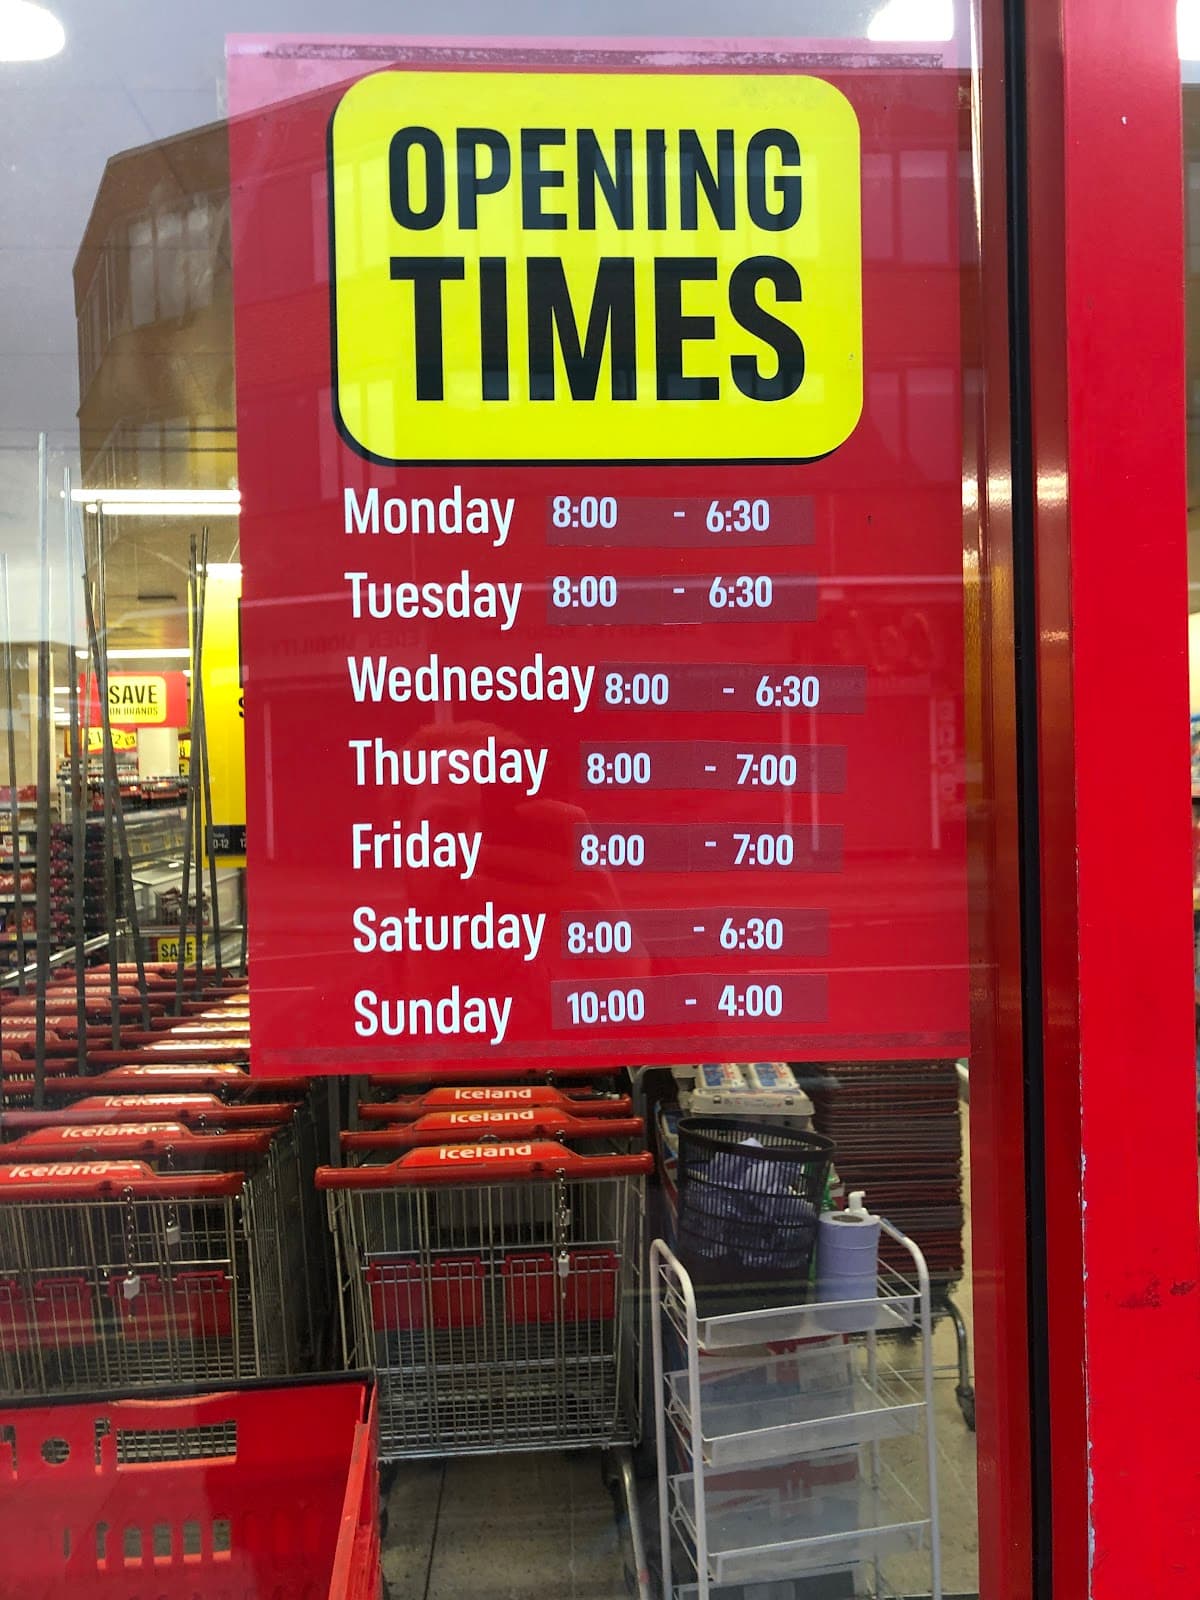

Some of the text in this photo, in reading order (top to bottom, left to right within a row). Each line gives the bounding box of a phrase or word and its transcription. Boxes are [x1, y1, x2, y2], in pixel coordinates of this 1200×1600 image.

[389, 126, 802, 232] OPENING
[389, 255, 805, 402] TIMES
[344, 485, 515, 547] Monday
[551, 495, 618, 529] 8:00
[706, 499, 770, 533] 6:30
[344, 569, 523, 631] Tuesday
[551, 575, 618, 608] 8:00
[708, 575, 773, 609] 6:30
[109, 685, 158, 704] SAVE
[347, 652, 596, 713] Wednesday
[604, 672, 669, 706] 8:00
[755, 675, 820, 708] 6:30
[348, 735, 549, 797] Thursday
[586, 752, 651, 786] 8:00
[736, 753, 797, 787] 7:00
[352, 819, 483, 881] Friday
[580, 834, 645, 867] 8:00
[733, 833, 794, 867] 7:00
[161, 942, 193, 957] SAE
[352, 901, 546, 962] Saturday
[567, 920, 632, 954] 8:00
[719, 917, 784, 951] 6:30
[354, 985, 513, 1046] Sunday
[566, 988, 645, 1025] 10:00
[717, 984, 783, 1018] 4:00
[450, 1110, 534, 1124] Iceland
[455, 1088, 532, 1100] Iceland
[62, 1124, 148, 1138] Iceland
[440, 1144, 532, 1160] Iceland
[9, 1163, 107, 1178] Iceland
